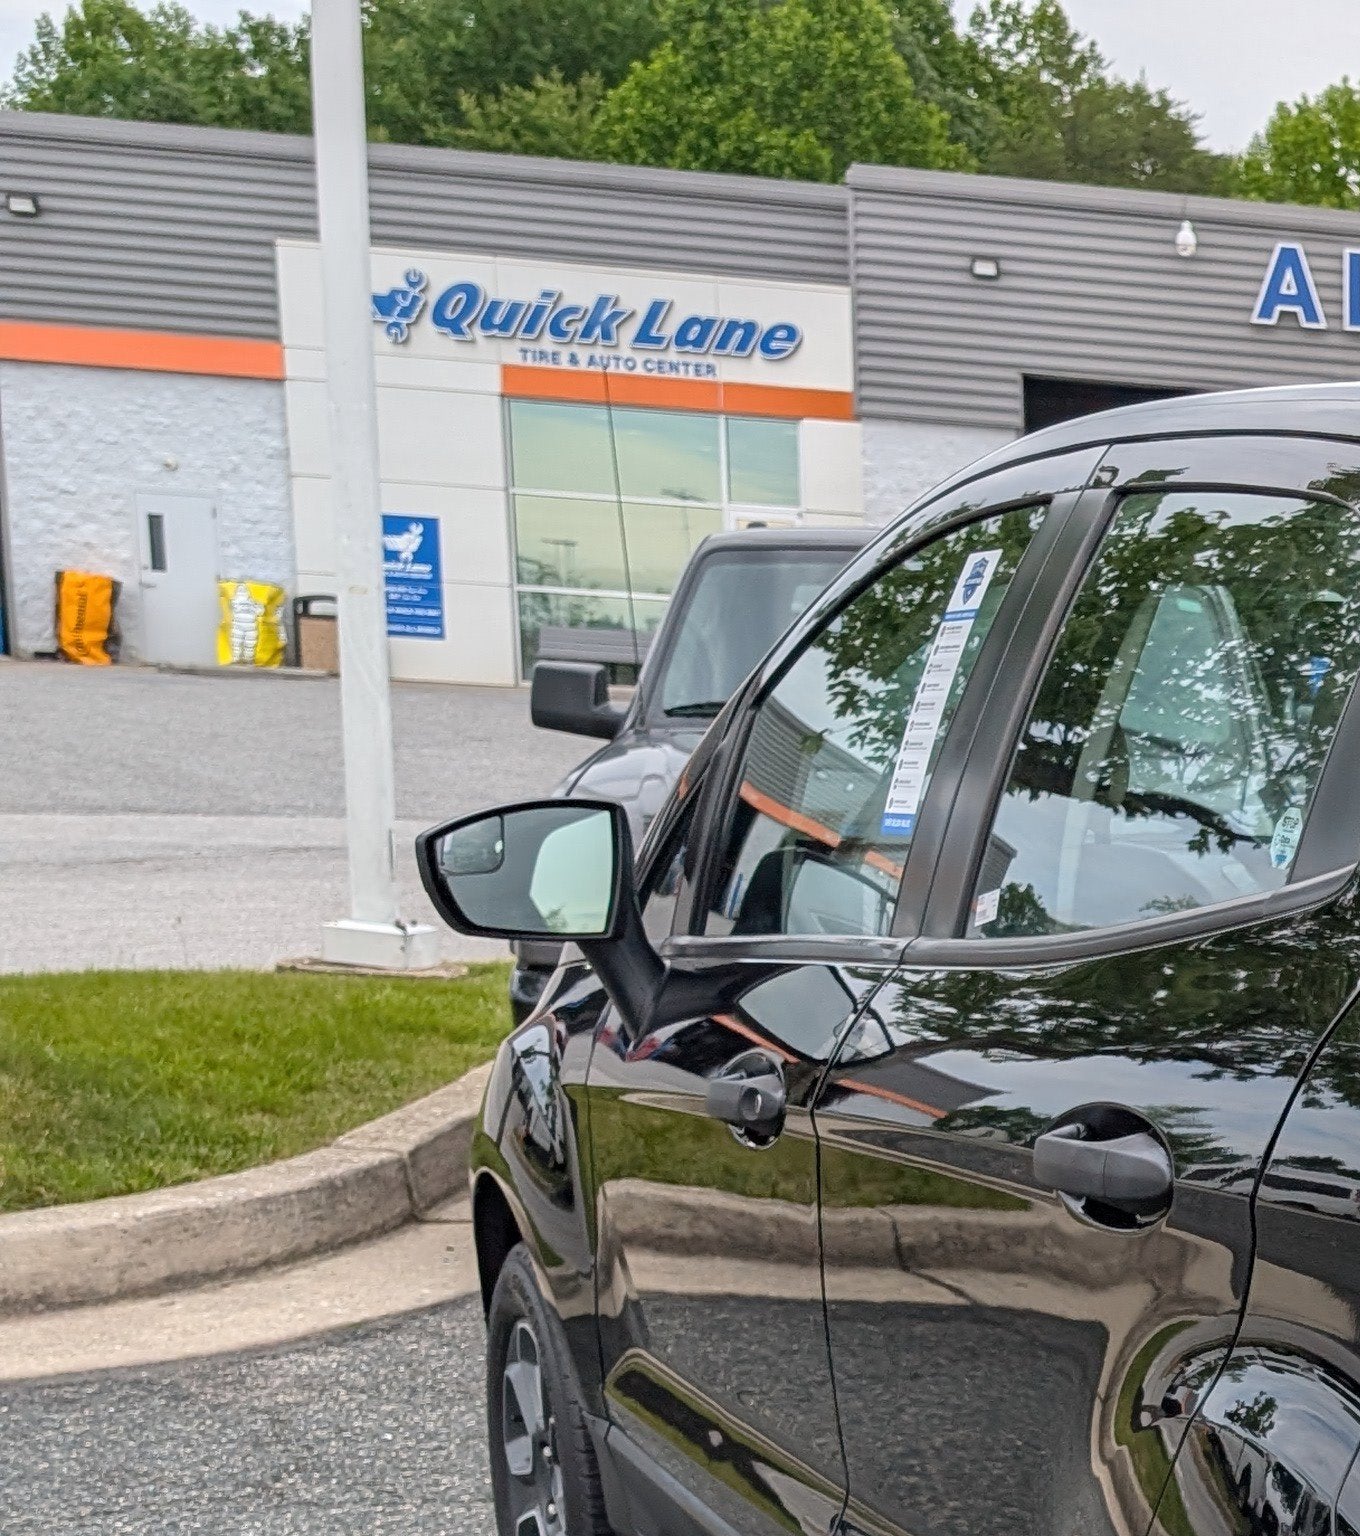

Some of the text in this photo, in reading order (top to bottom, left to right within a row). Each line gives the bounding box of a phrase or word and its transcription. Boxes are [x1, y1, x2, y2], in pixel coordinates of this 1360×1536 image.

[431, 280, 803, 360] Quick Lane
[519, 347, 562, 365] TIRE
[587, 353, 637, 371] AUTO
[642, 358, 717, 377] CENTER
